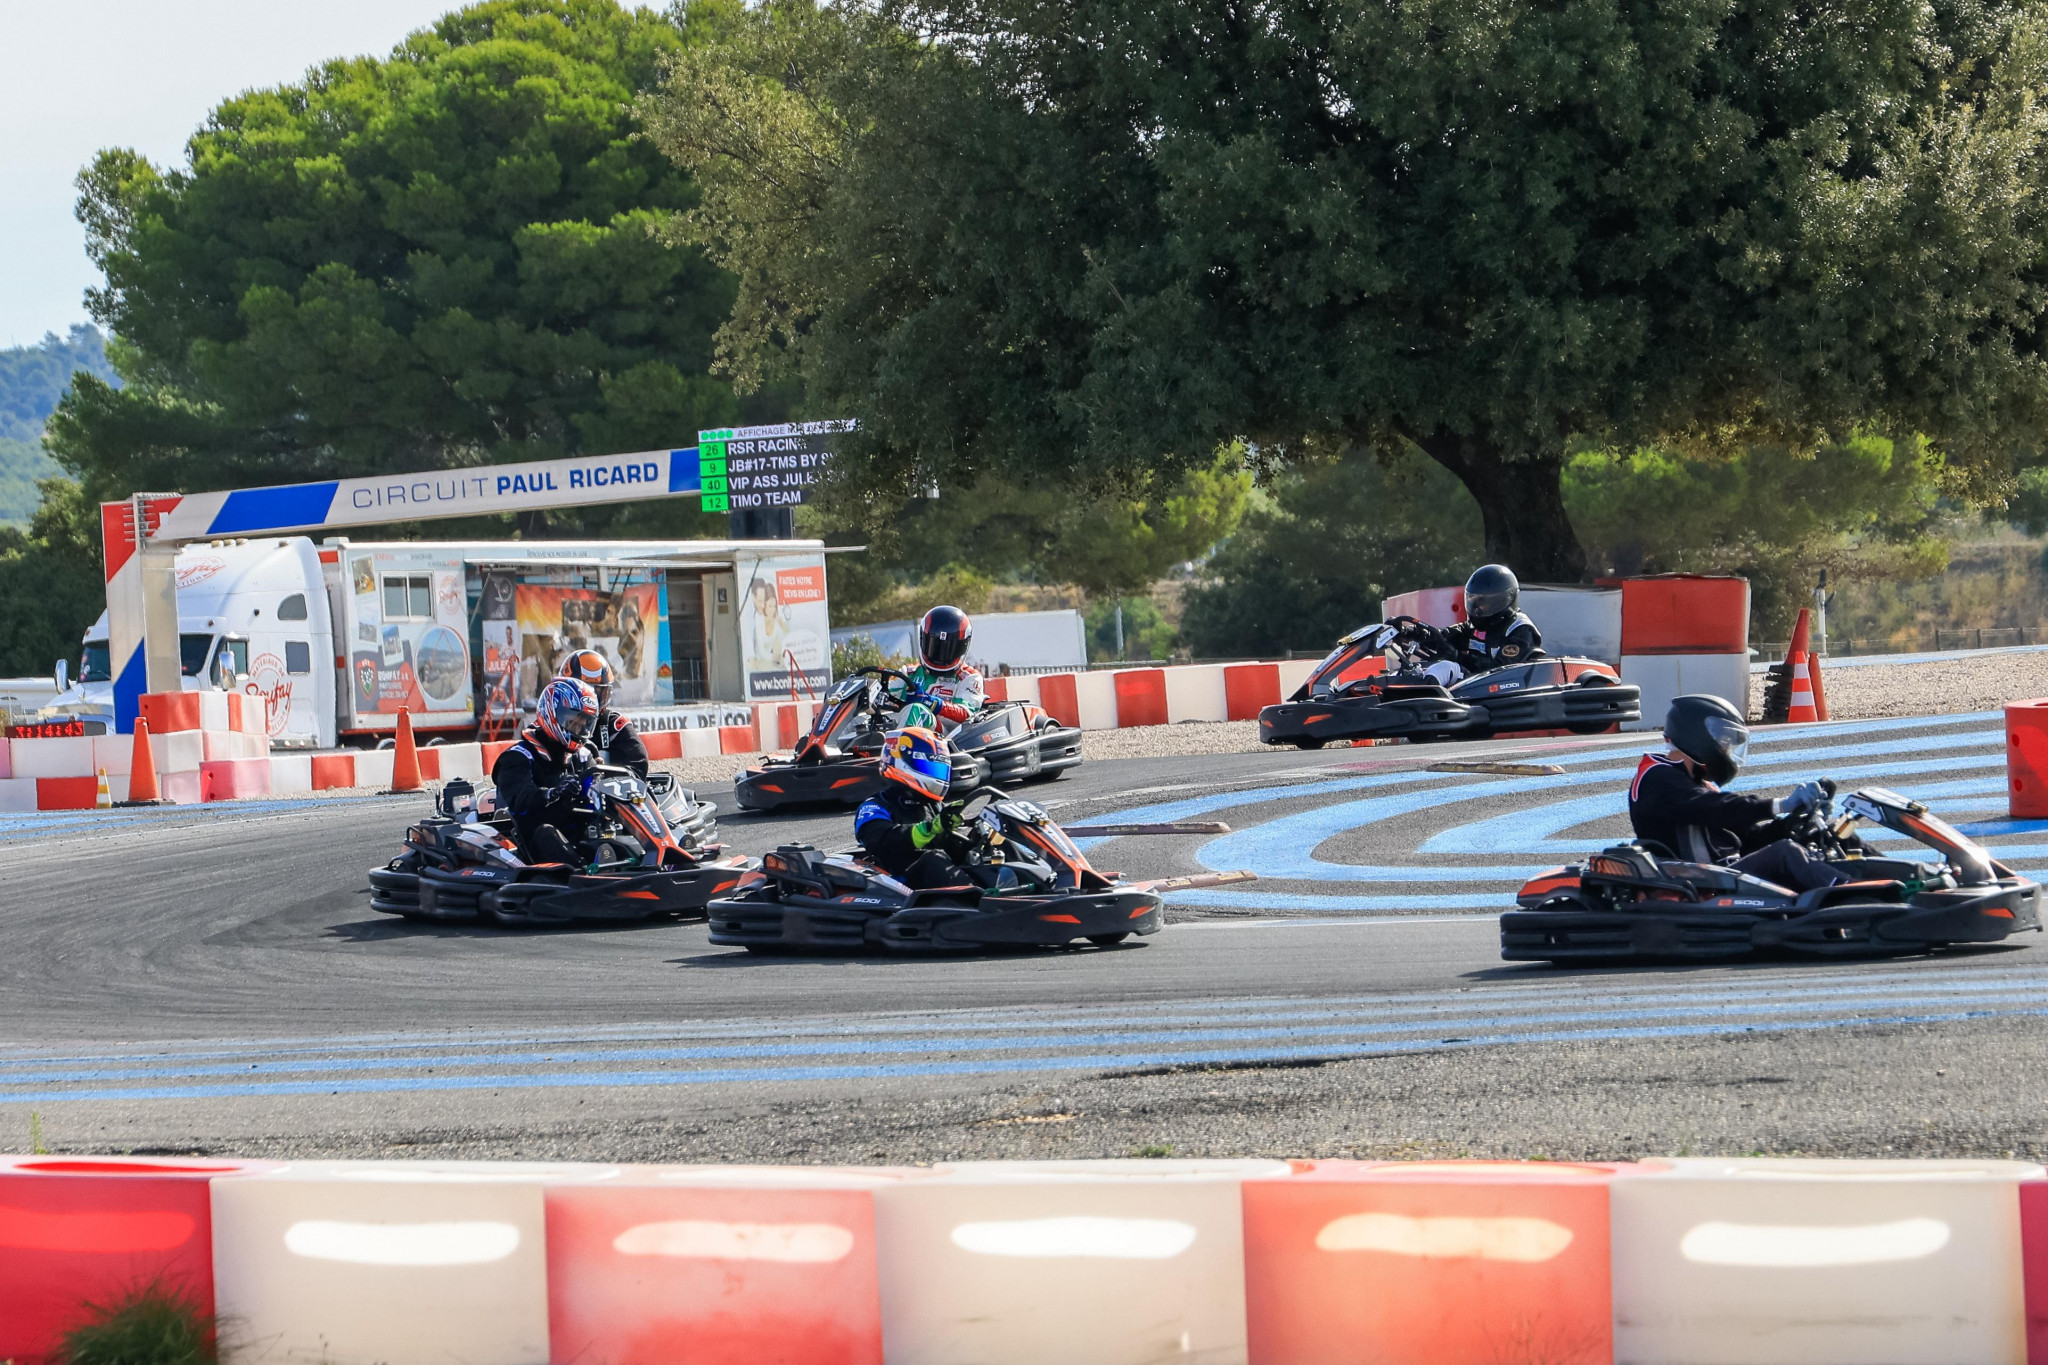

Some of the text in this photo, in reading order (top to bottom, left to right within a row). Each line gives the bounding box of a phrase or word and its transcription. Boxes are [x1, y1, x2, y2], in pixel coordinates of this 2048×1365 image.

[737, 427, 785, 438] AFFICHAGE
[705, 444, 719, 457] 26
[728, 441, 755, 456] RSR
[709, 463, 716, 473] 9
[728, 456, 797, 473] JB#17-TMS
[801, 453, 818, 467] BY
[353, 462, 659, 509] CIRCUIT PAUL RICARD
[707, 480, 720, 491] 40
[729, 477, 749, 491] VIP
[752, 475, 779, 489] ASS
[709, 497, 721, 509] 12
[730, 491, 801, 509] TIMO TEAM
[796, 576, 813, 585] VOTRE
[631, 715, 688, 733] ERIAUX
[697, 714, 716, 729] DE
